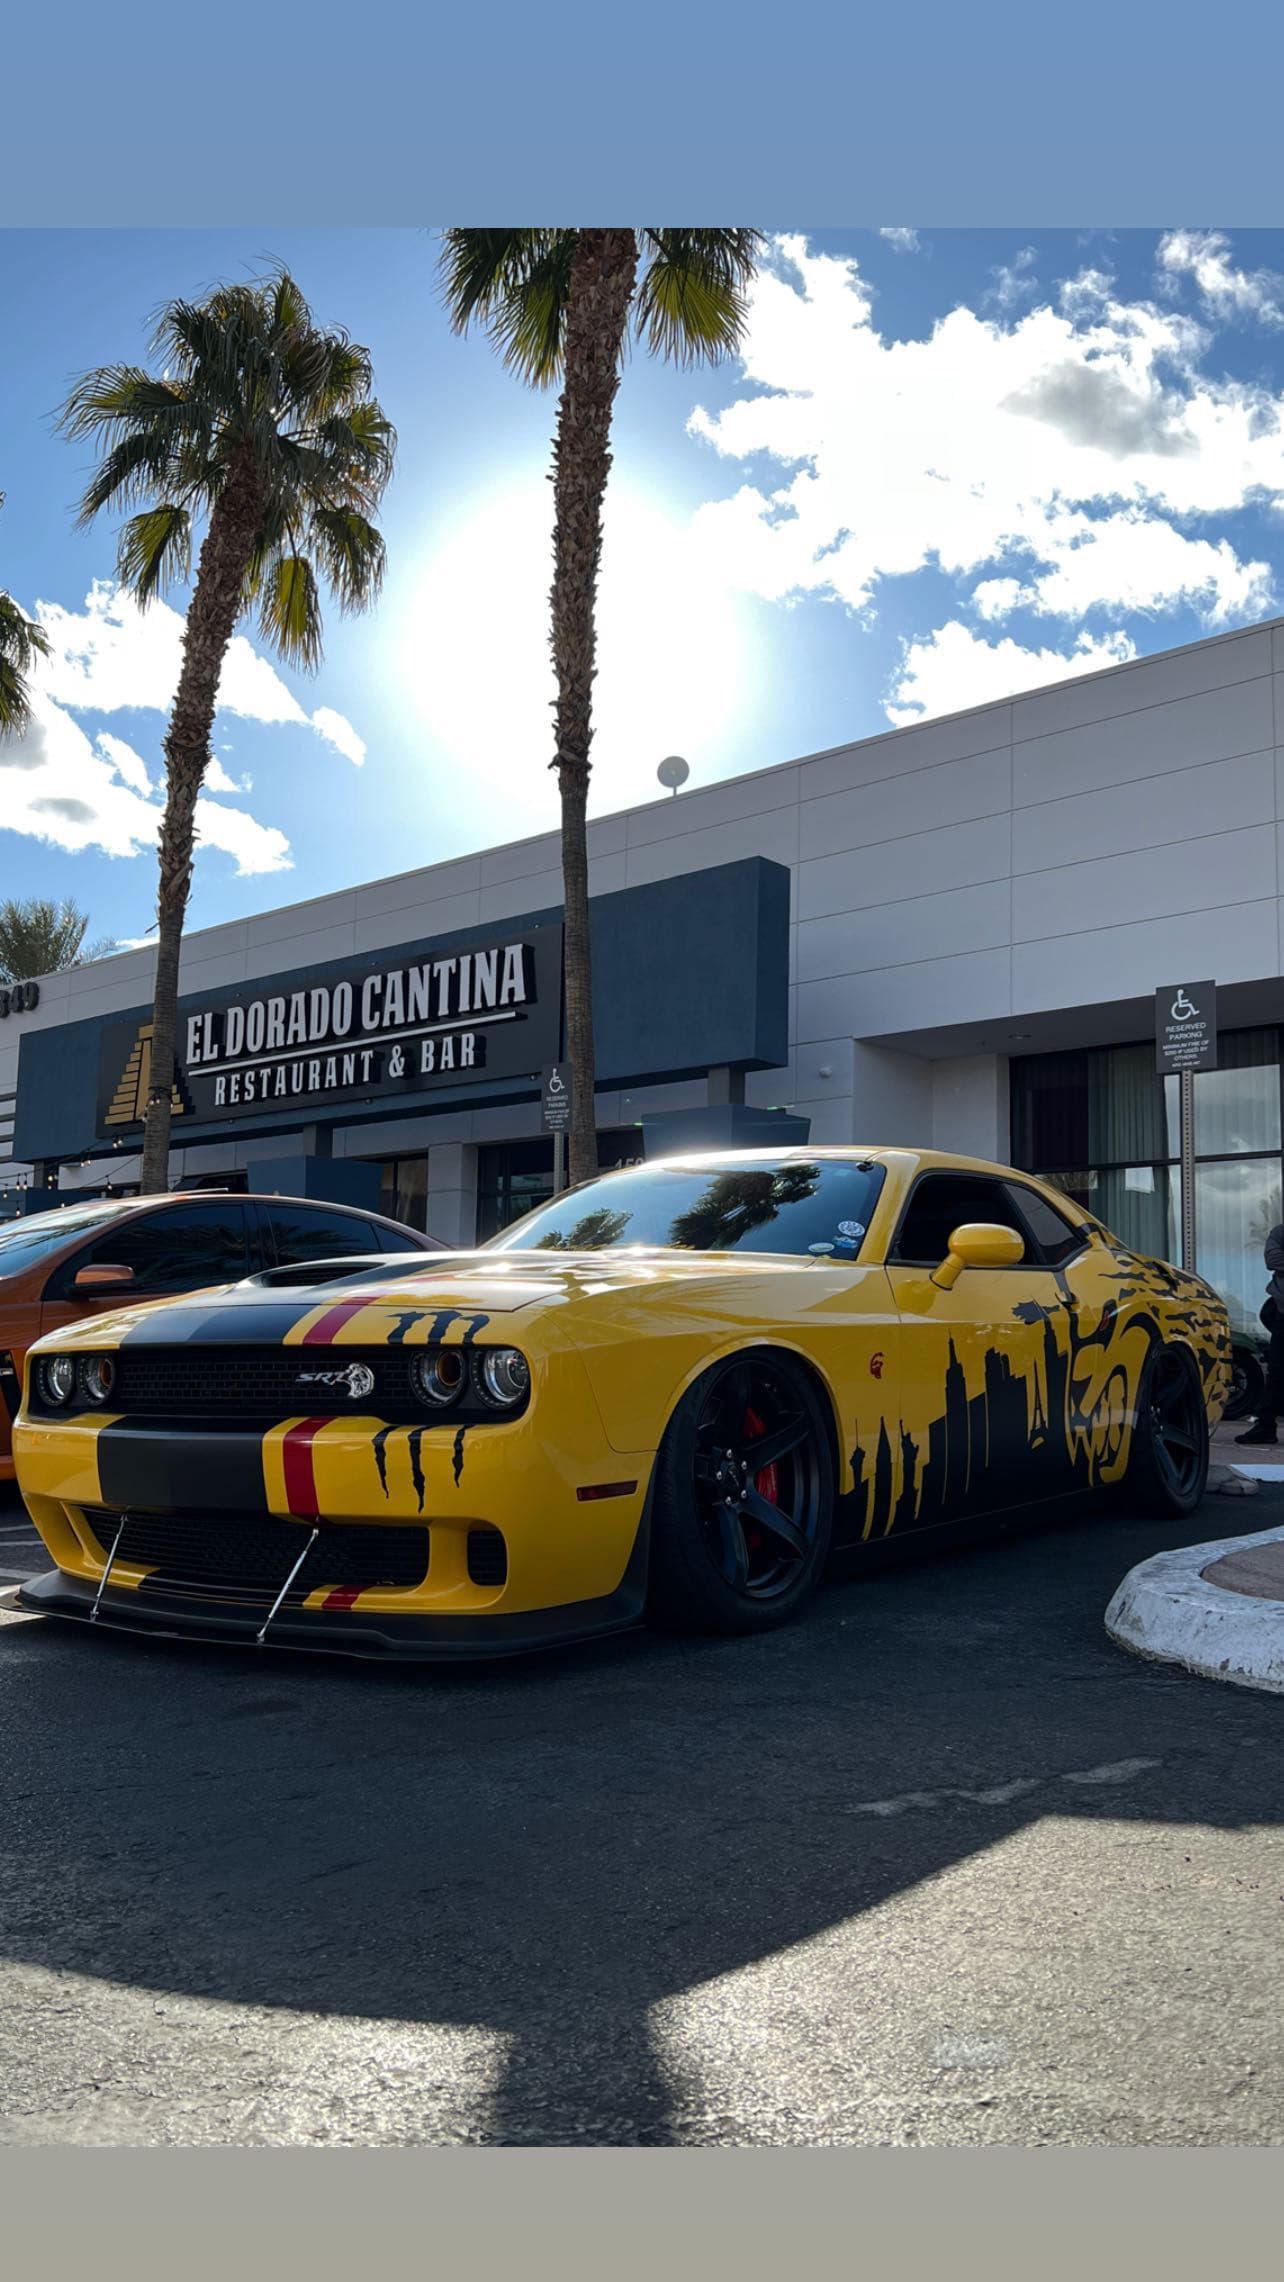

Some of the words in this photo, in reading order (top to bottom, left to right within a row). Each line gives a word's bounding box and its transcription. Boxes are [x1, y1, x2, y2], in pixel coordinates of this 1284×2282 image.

[186, 1012, 219, 1064] EL
[225, 981, 353, 1057] DORADO
[362, 943, 526, 1031] CANTINA
[1165, 1022, 1207, 1033] RESERVED
[1169, 1031, 1203, 1040] PARKING
[214, 1050, 374, 1106] RESTAURANT
[388, 1045, 405, 1078] &
[421, 1032, 475, 1073] BAR
[295, 1371, 351, 1386] SRT
